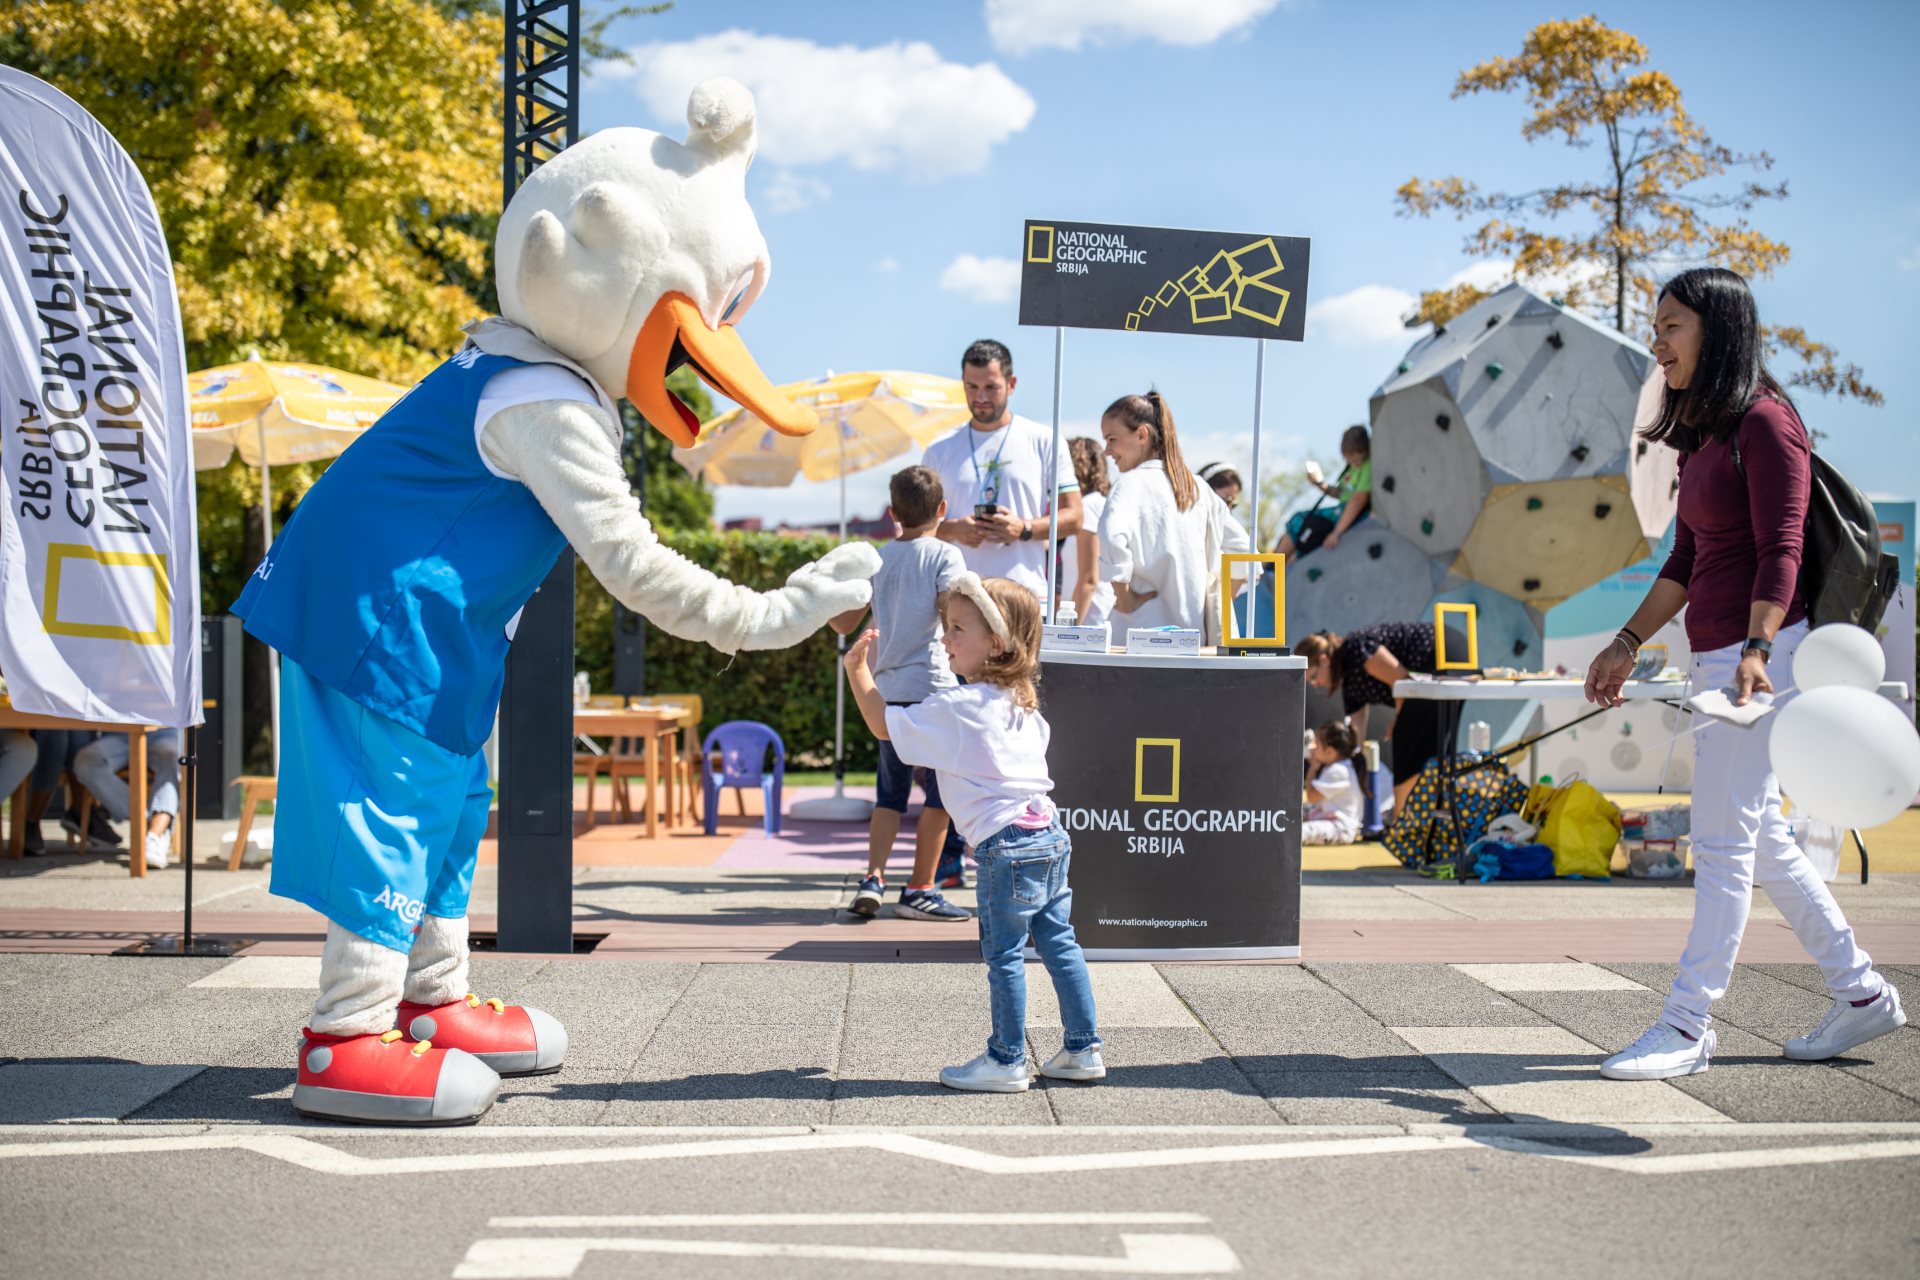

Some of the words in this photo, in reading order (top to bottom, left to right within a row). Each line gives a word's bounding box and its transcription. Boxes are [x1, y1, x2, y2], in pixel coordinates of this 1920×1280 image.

[1057, 230, 1128, 249] NATIONAL
[1056, 245, 1147, 265] GEOGRAPHIC
[1056, 262, 1089, 276] SRBIJA
[1144, 808, 1287, 832] GEOGRAPHIC
[1127, 836, 1185, 858] SRBIJA
[1098, 917, 1208, 928] www.nationalgeographic.rs
